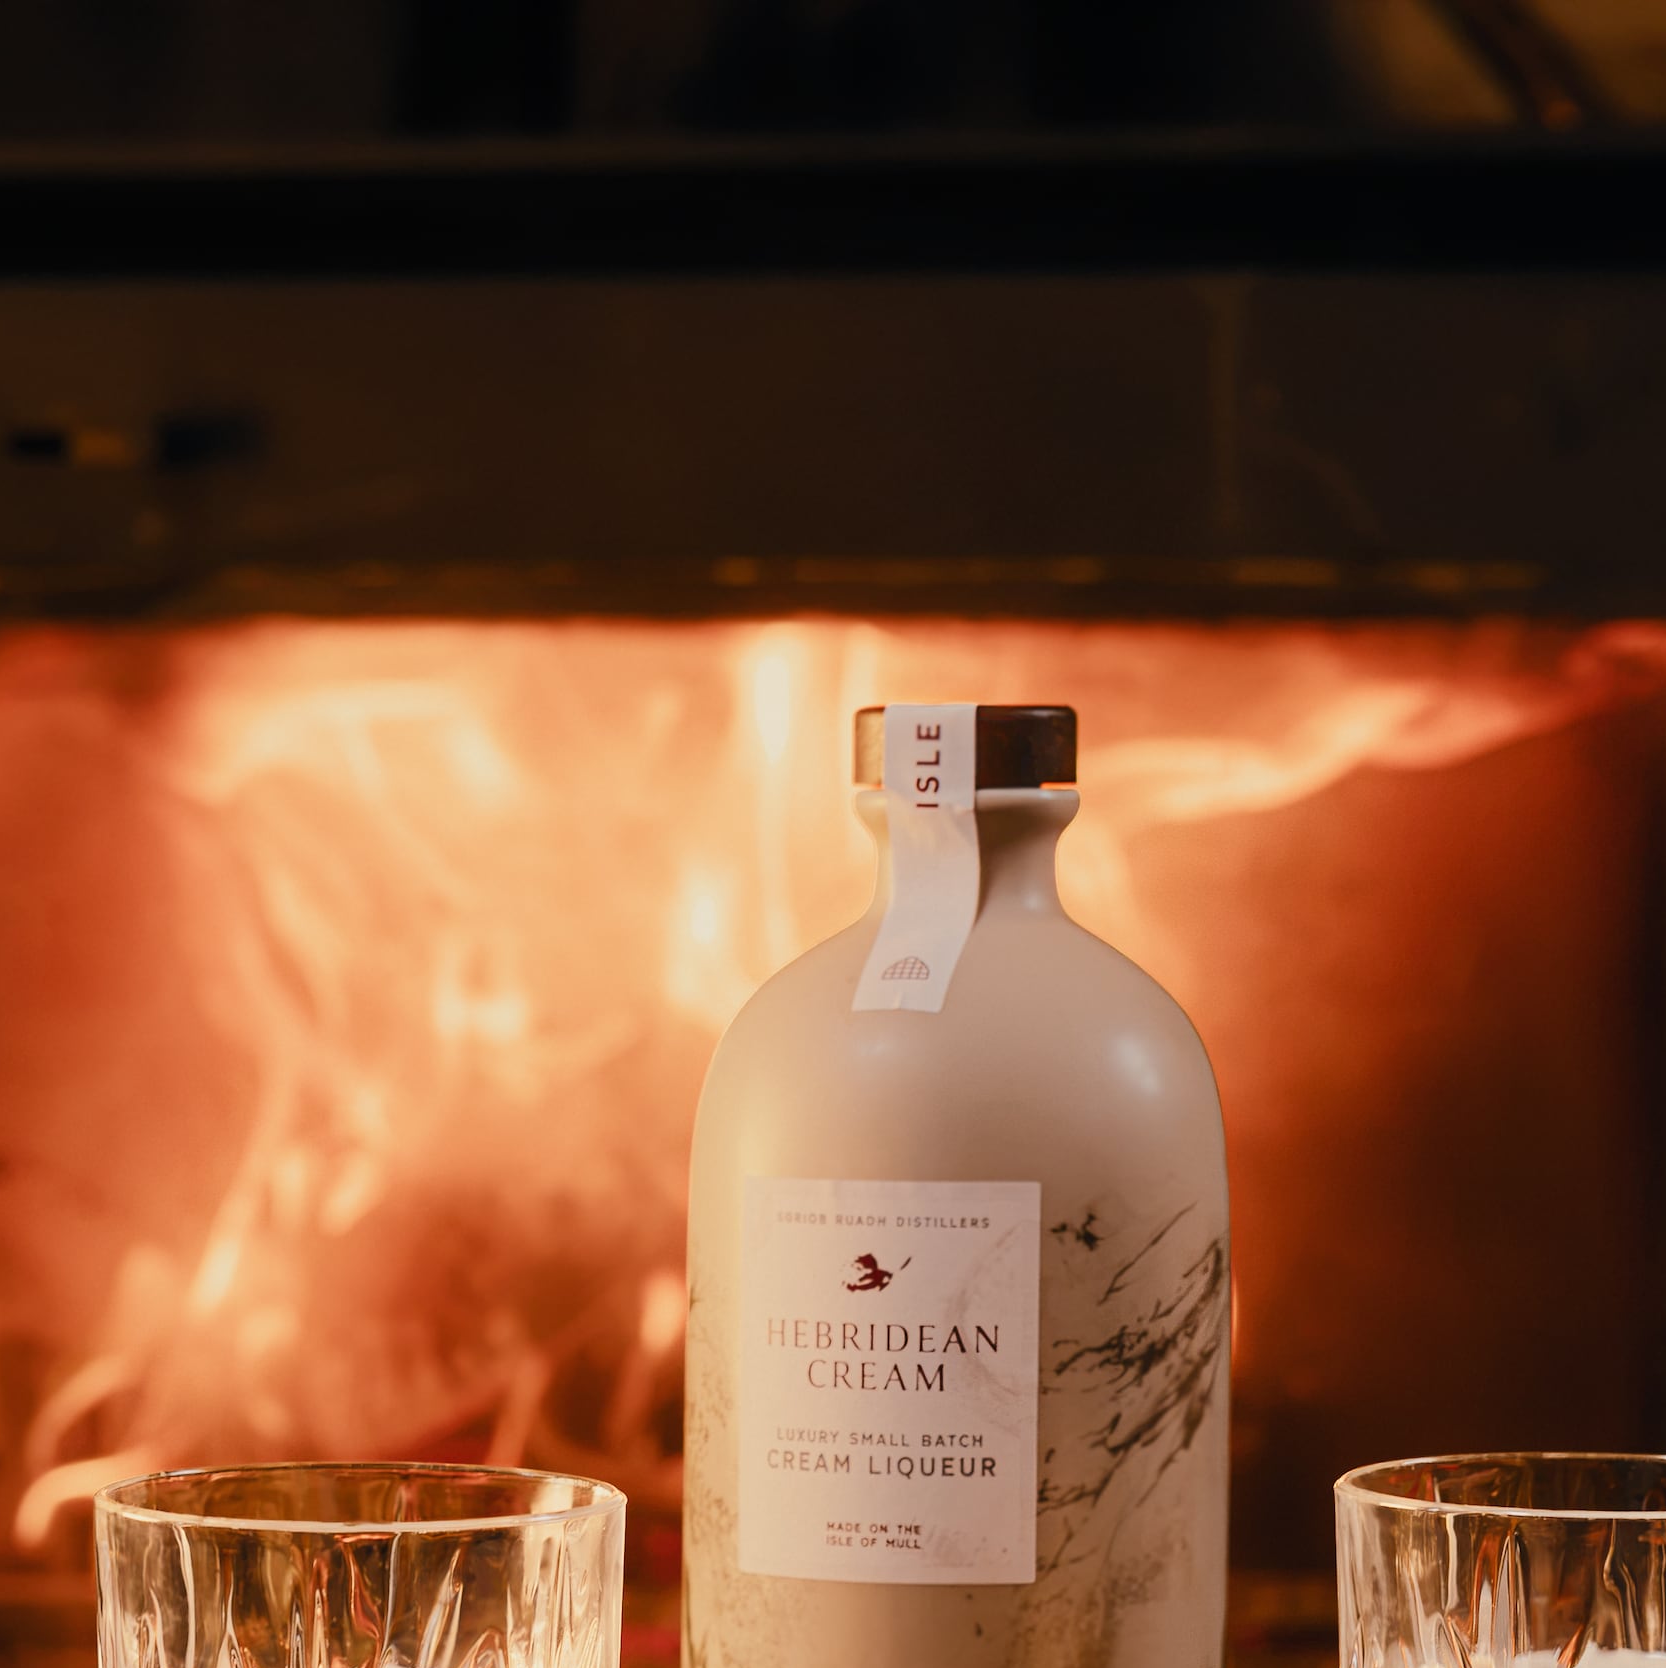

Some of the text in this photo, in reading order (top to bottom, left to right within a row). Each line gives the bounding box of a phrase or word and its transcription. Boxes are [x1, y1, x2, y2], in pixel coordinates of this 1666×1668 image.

[915, 722, 942, 809] ISLE
[835, 1213, 887, 1227] RUADH
[896, 1216, 991, 1229] DISTILLERS
[767, 1317, 1000, 1354] HEBRIDEAN
[807, 1358, 946, 1392] CREAM
[776, 1427, 984, 1448] LUXURY SMALL BATCH
[766, 1449, 997, 1479] CREAM LIQUEUR
[826, 1521, 922, 1536] MADE ON THE
[825, 1535, 922, 1549] ISLE OF MULL
